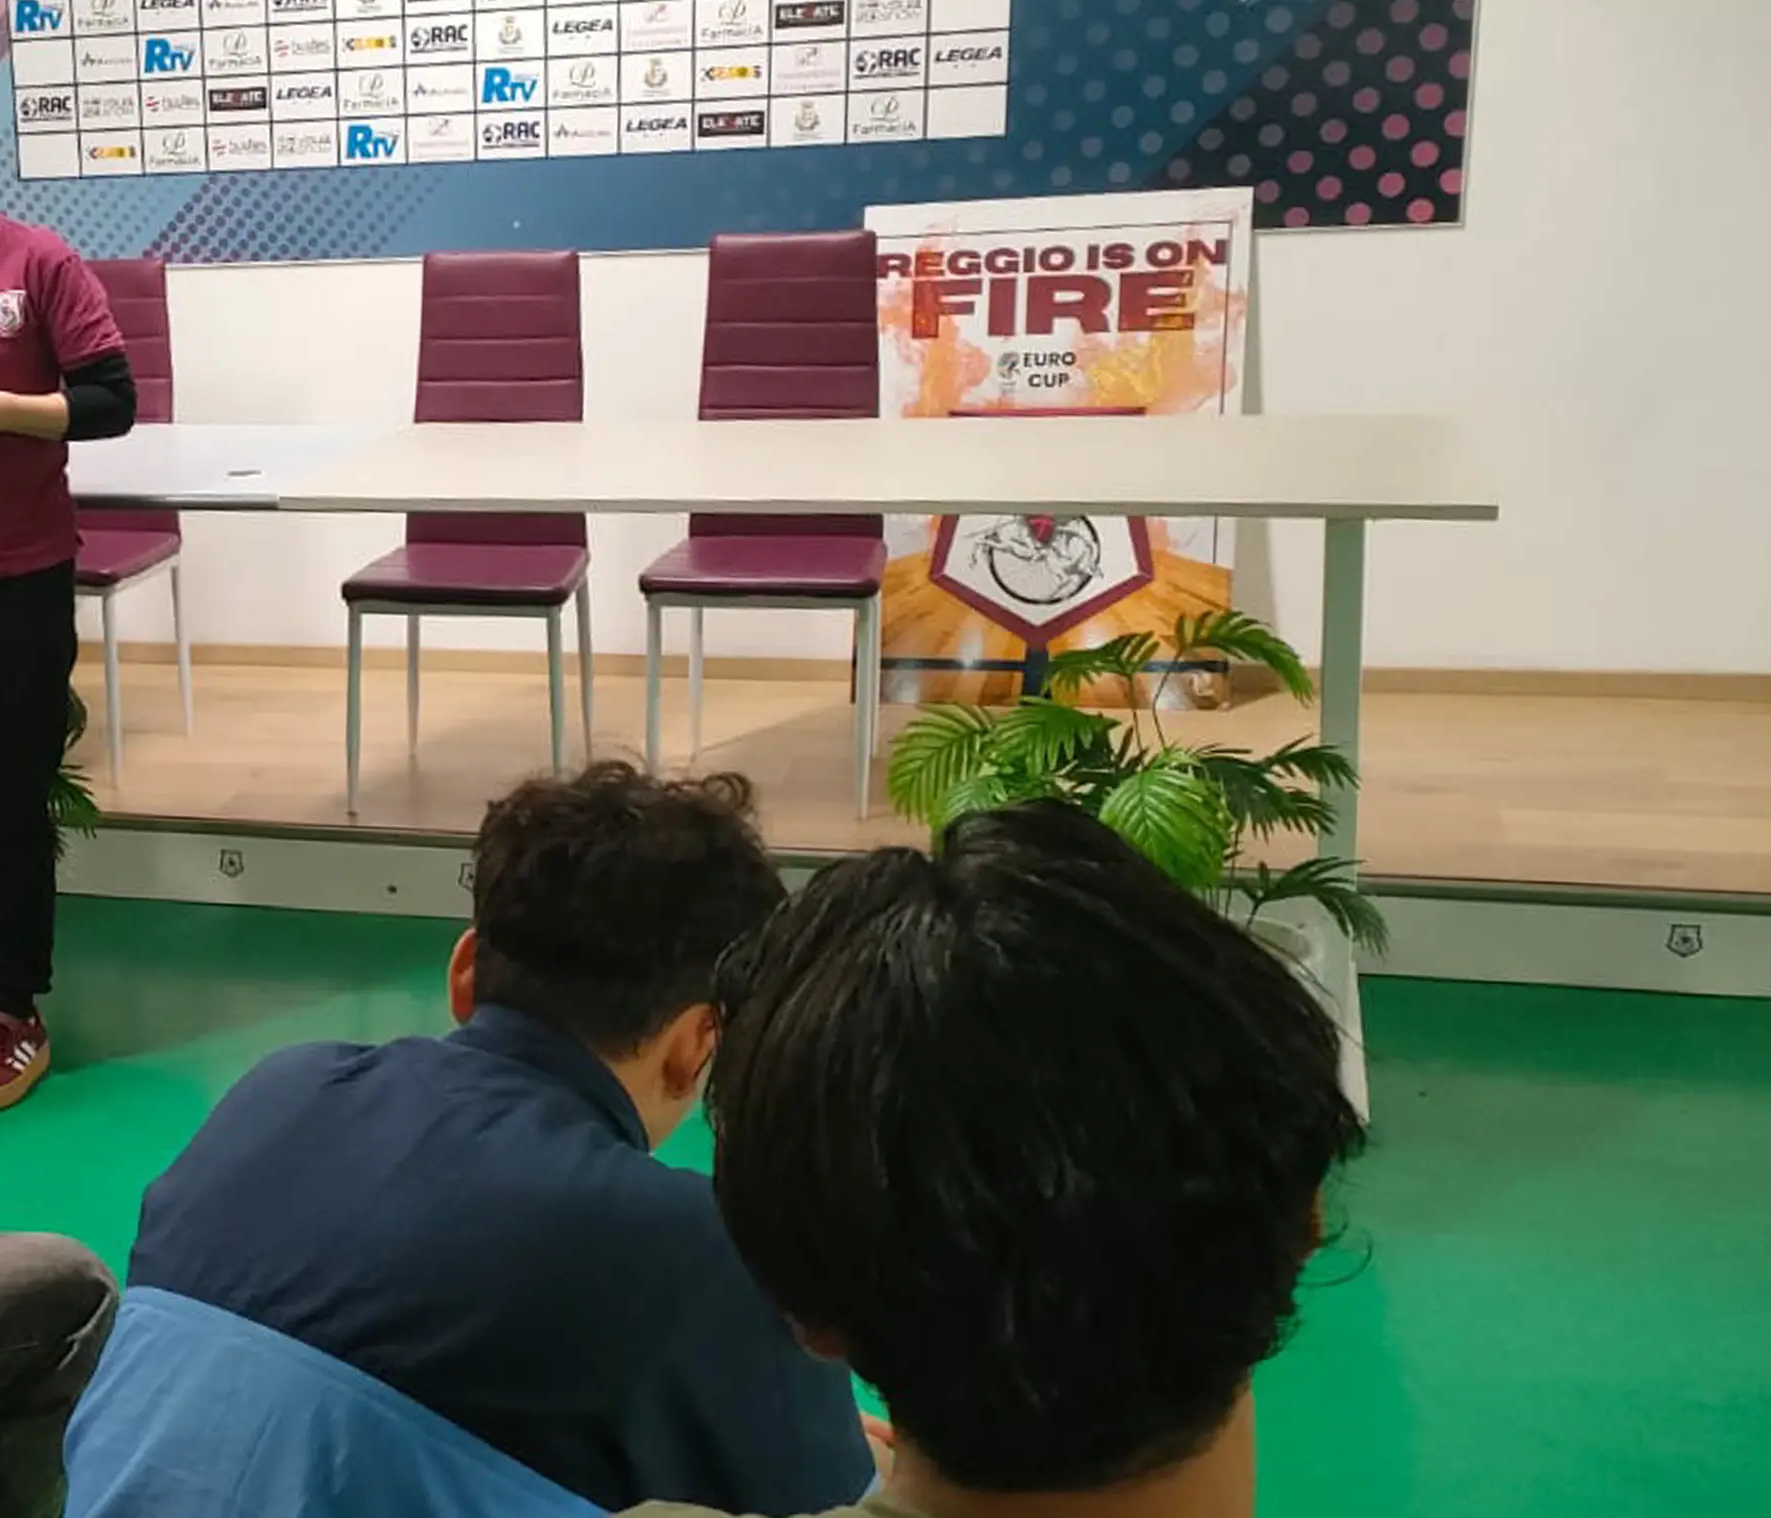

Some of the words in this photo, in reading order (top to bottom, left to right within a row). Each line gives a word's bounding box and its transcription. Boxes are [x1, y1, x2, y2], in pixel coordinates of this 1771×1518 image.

[431, 25, 468, 43] RAC
[552, 18, 613, 34] LEGEA
[879, 48, 921, 67] RAC
[934, 46, 1003, 62] LEGEA
[276, 86, 332, 101] LEGEA
[39, 96, 71, 113] RAC
[503, 122, 541, 139] RAC
[626, 117, 688, 132] LEGEA
[877, 246, 1076, 278] REGGIO
[1087, 243, 1136, 270] IS
[1145, 239, 1228, 268] ON
[911, 269, 1195, 339] FIRE
[1023, 352, 1077, 368] EURO
[1028, 372, 1070, 388] CUP
